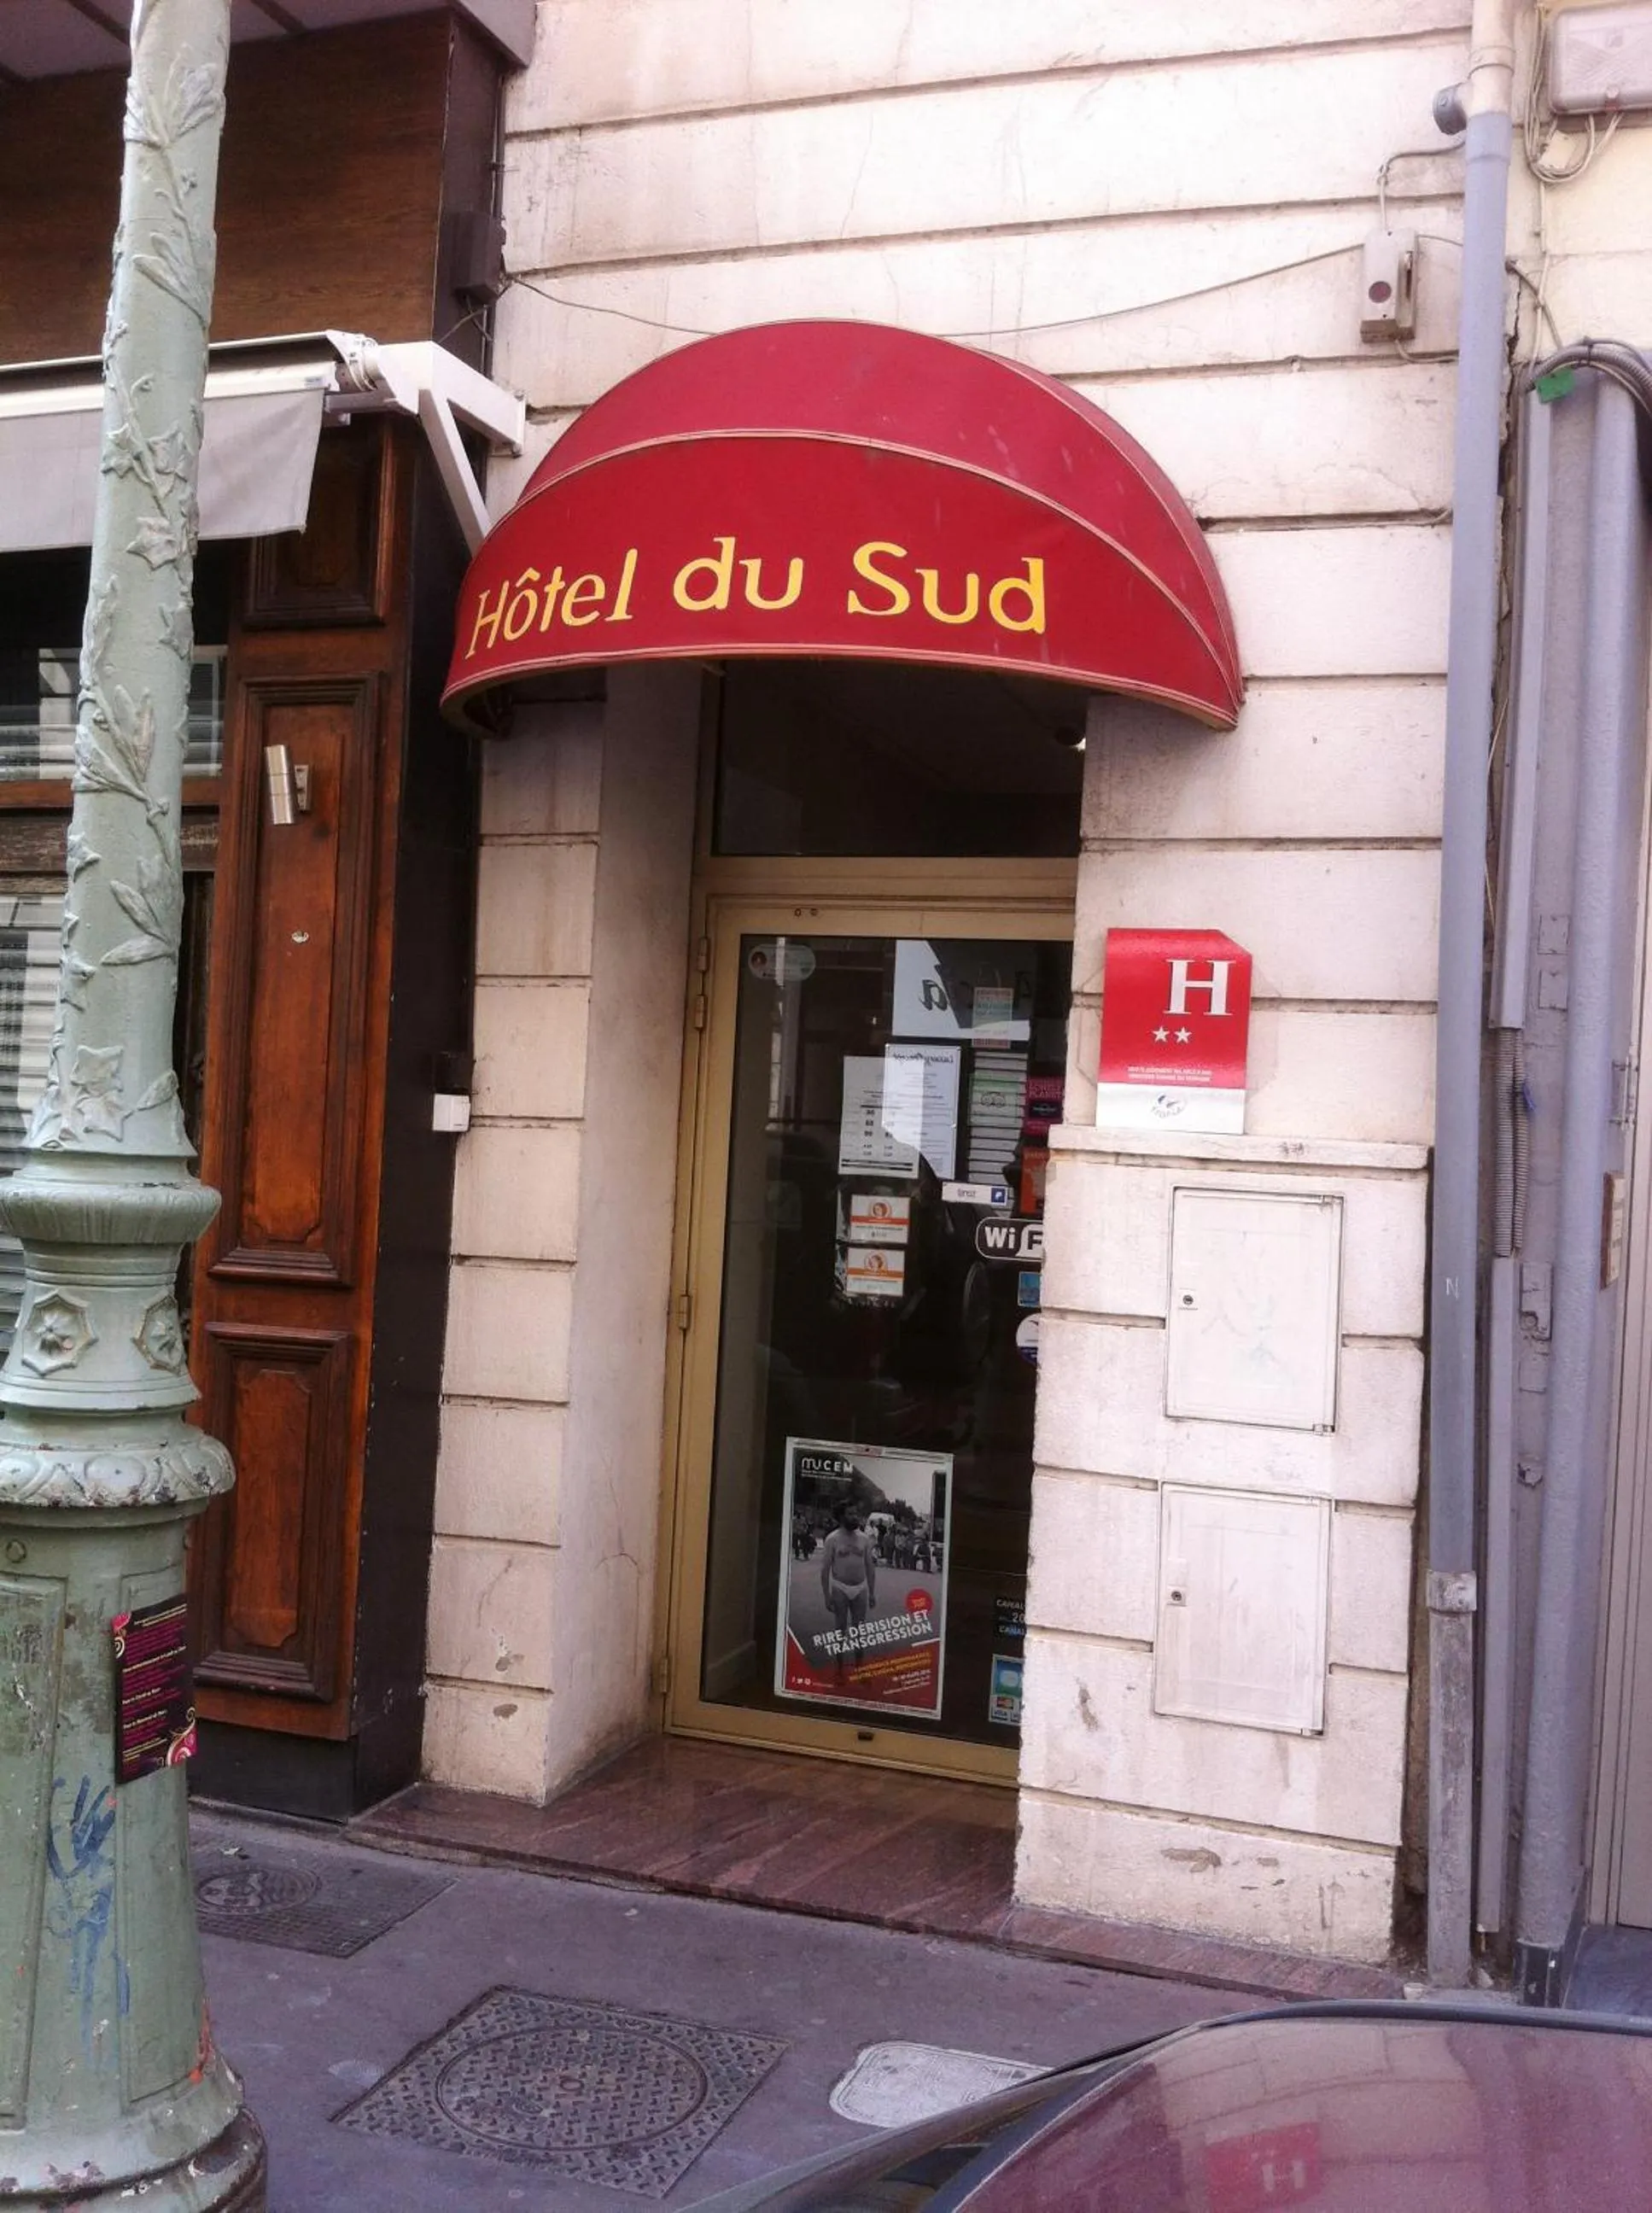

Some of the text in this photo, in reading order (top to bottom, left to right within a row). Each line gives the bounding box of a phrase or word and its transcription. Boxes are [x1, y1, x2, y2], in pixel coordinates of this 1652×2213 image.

[464, 535, 1047, 660] Hôtel du Sud
[1163, 958, 1236, 1016] H
[813, 1630, 849, 1647] RIRE,
[913, 1609, 929, 1622] ET
[824, 1621, 933, 1656] TRANSGRESSION
